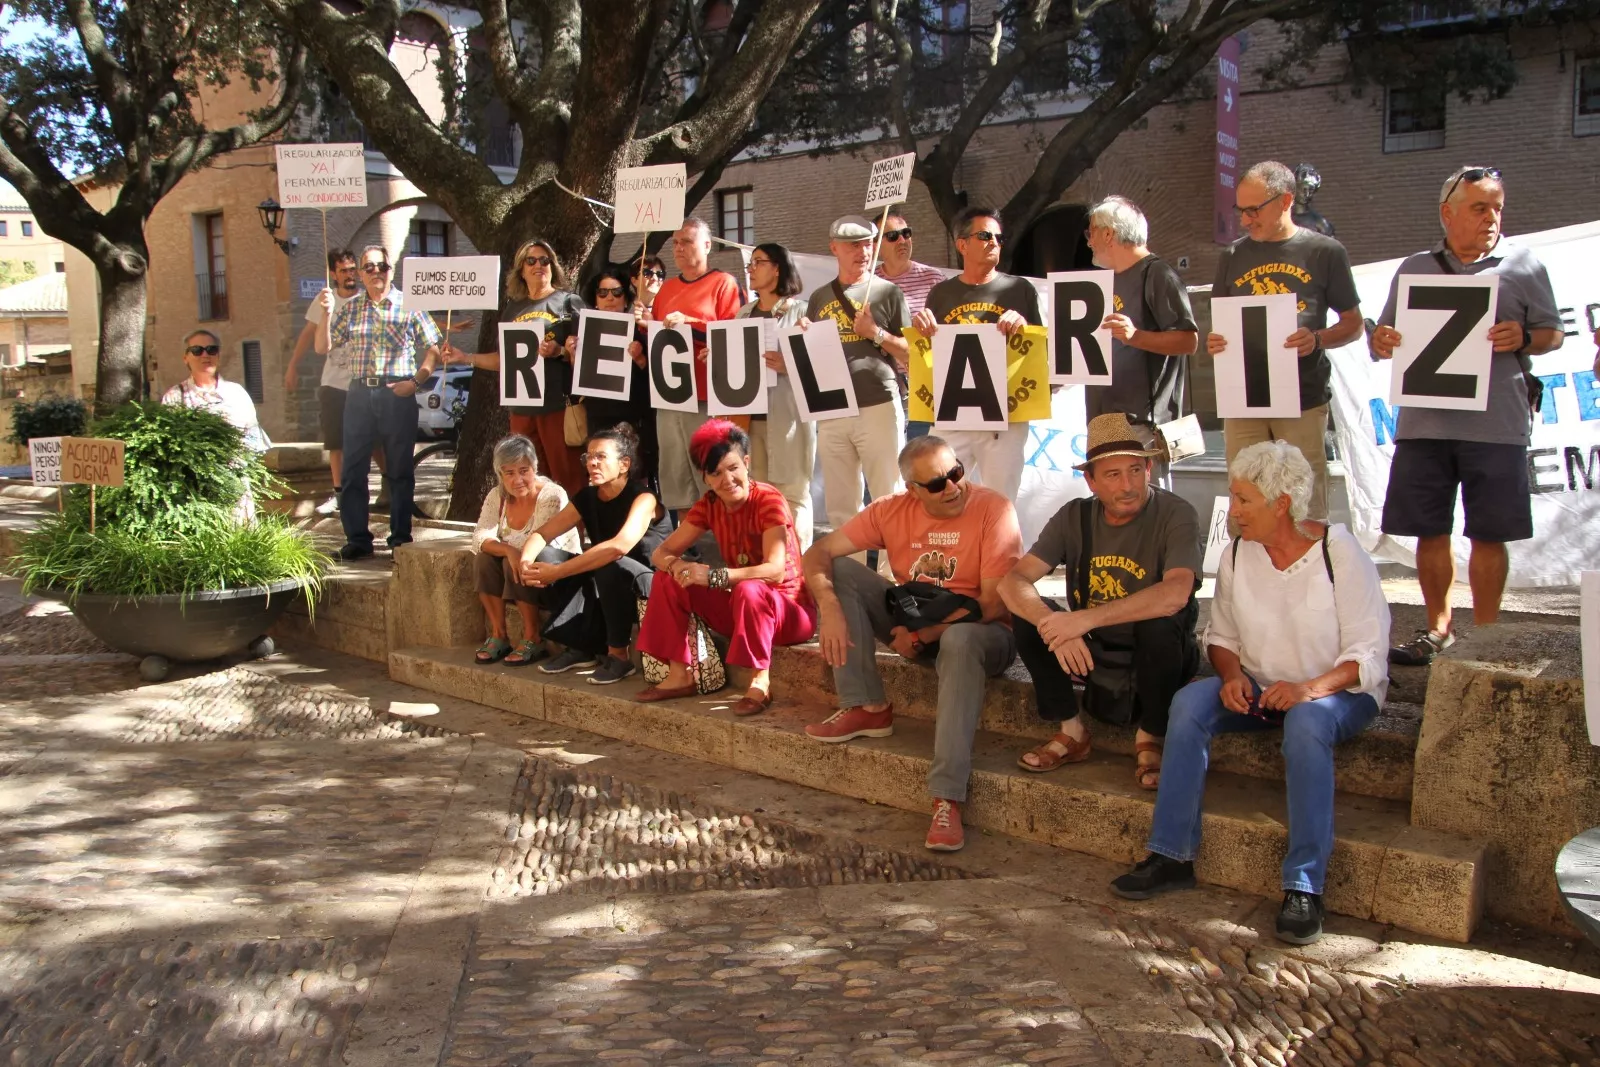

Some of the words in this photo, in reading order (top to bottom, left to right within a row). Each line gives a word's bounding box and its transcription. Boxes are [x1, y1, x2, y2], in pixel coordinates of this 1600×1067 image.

[873, 156, 905, 176] NINGUNA
[284, 176, 363, 188] PERMANENTE
[870, 171, 904, 189] PERSONA
[285, 194, 302, 204] SIN
[306, 192, 364, 203] CONDICIONES
[866, 189, 877, 203] ES
[877, 183, 902, 200] ILEGAL
[634, 197, 662, 225] YA!
[1179, 258, 1188, 269] 4
[415, 271, 447, 282] FUIMOS
[450, 271, 477, 282] EXILIO
[1234, 263, 1313, 288] REFUGIADXS
[411, 284, 445, 296] SEAMOS
[448, 285, 486, 296] REFUGIO
[66, 443, 118, 466] ACOGIDA
[36, 470, 46, 482] ES
[73, 462, 110, 483] DIGNA
